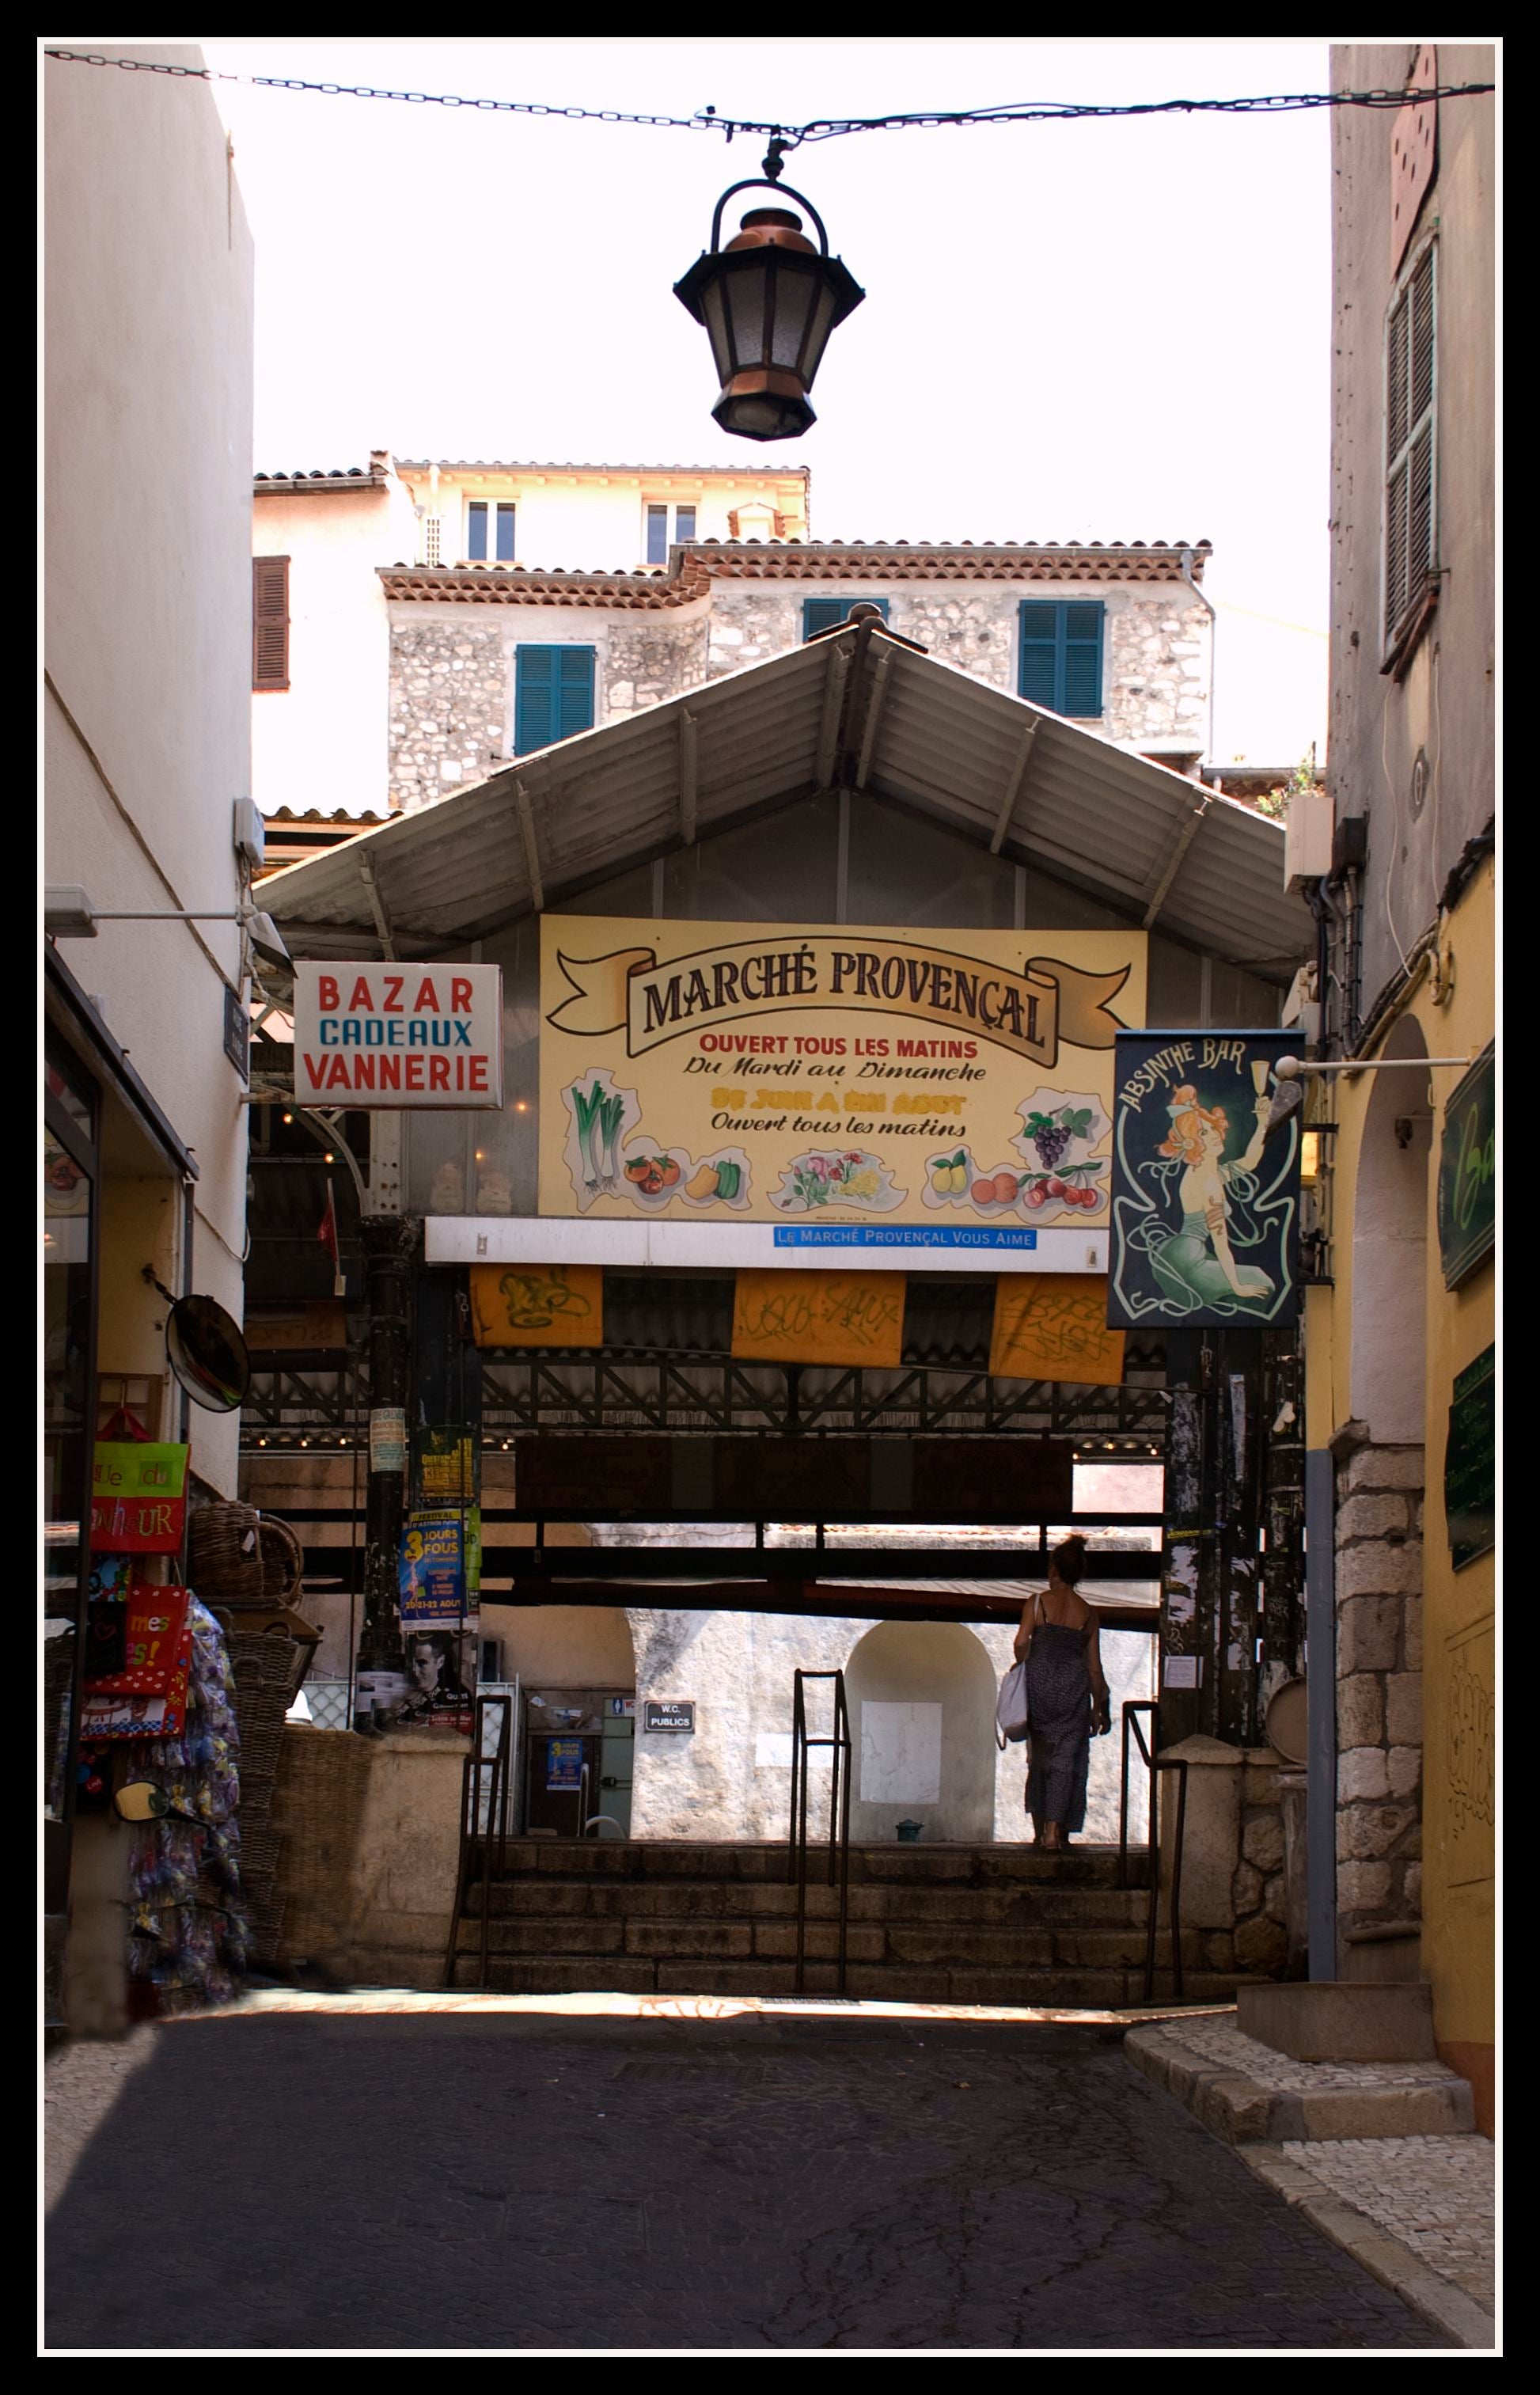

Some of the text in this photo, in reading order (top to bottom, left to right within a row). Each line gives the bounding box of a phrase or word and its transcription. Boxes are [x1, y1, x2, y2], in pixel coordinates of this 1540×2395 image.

[319, 976, 473, 1013] BAZAR
[643, 943, 1045, 1048] MARCHÉ PROVENÇAL
[320, 1019, 472, 1047] CADEAUX
[700, 1034, 978, 1058] OUVERT TOUS LES MATINS
[302, 1053, 489, 1091] VANNERIE
[683, 1057, 987, 1081] Du Mardi au Dimanche
[1118, 1038, 1247, 1113] ABSINTHE BAR
[711, 1112, 966, 1137] Ouvert tous les matins
[419, 1511, 453, 1520] FESTIVAL
[404, 1530, 423, 1562] 3
[424, 1528, 458, 1540] JOURS
[424, 1542, 459, 1555] FOUS
[131, 1615, 171, 1632] mes
[651, 1717, 690, 1726] PUBLICS
